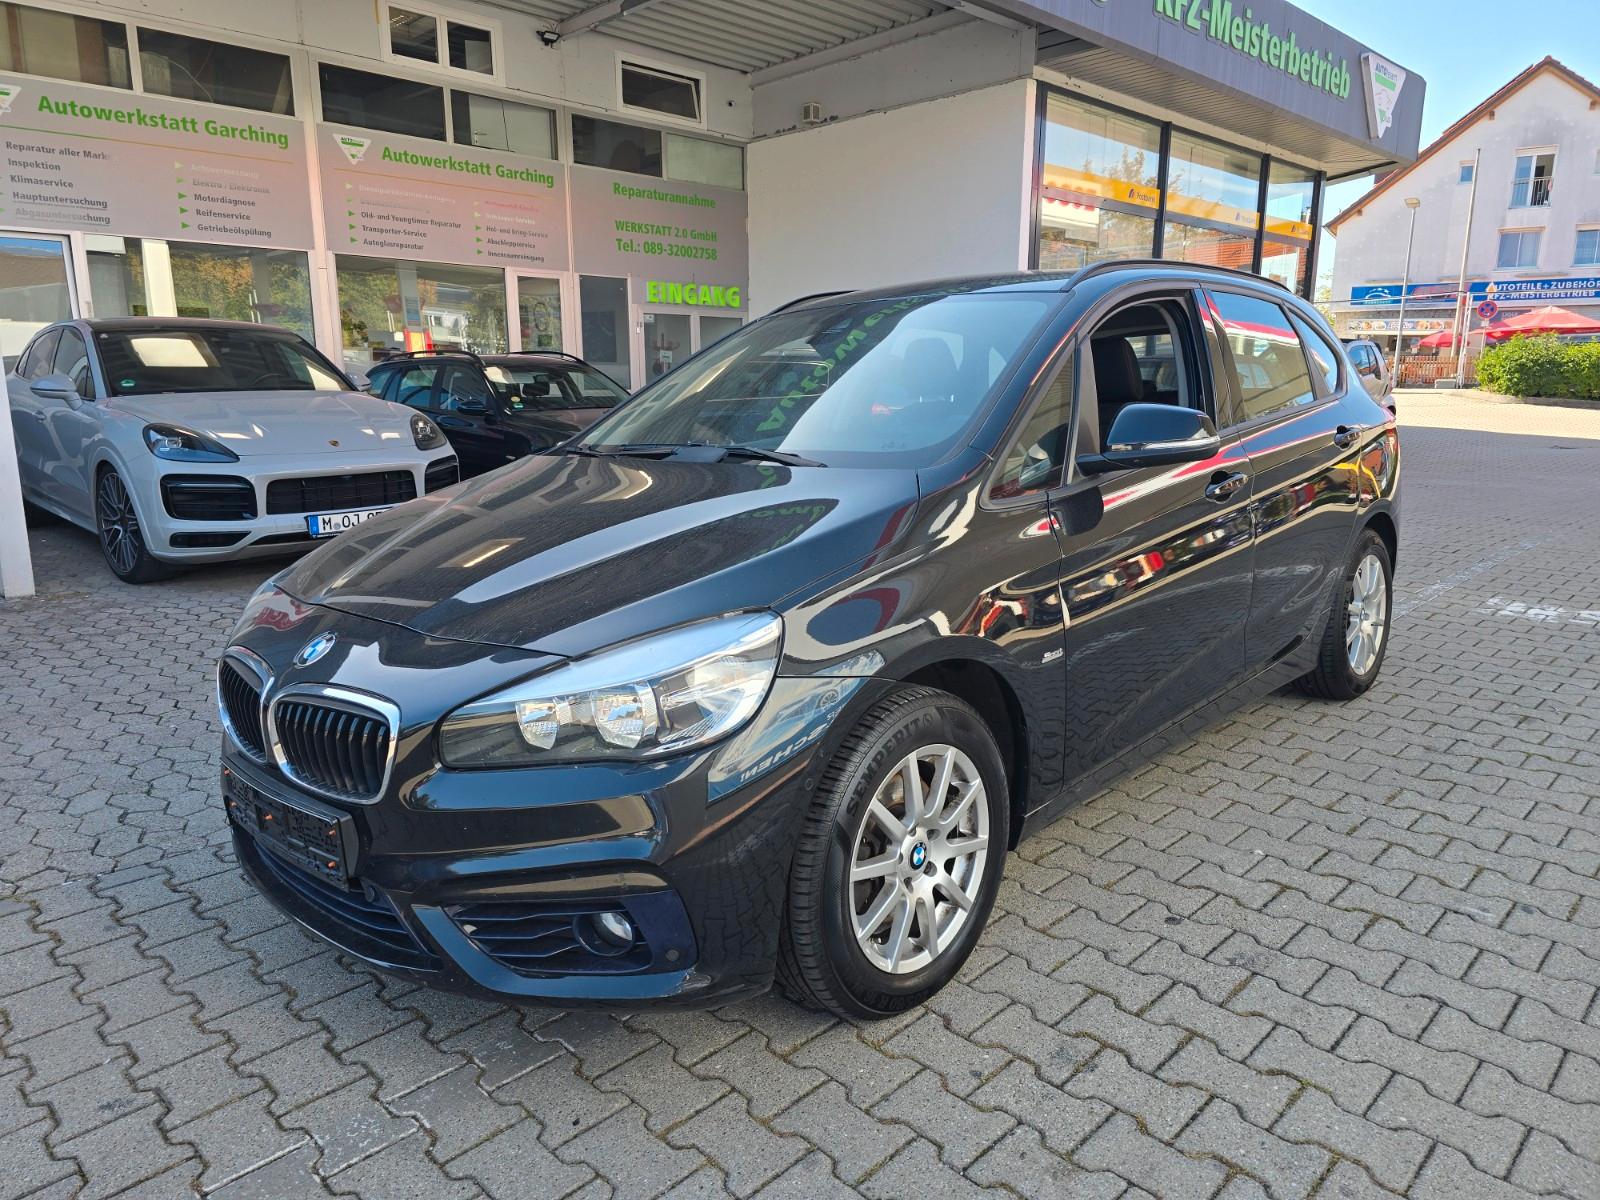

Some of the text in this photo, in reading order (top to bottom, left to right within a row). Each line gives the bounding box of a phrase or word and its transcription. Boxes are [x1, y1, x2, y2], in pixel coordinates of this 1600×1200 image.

[38, 95, 289, 149] Autowerkstatt Garching
[5, 141, 111, 160] Reparatur aller Mark
[8, 158, 61, 171] Inspektion
[382, 146, 555, 188] Autowerkstatt Garching
[10, 174, 74, 188] Klimaservice
[12, 191, 108, 209] Hauptuntersuchung
[194, 193, 256, 207] Motordiagnose
[613, 182, 716, 208] Reparaturannahme
[195, 208, 251, 221] Reifenservice
[197, 223, 272, 239] Getriebeölspülung
[362, 225, 428, 238] Transporter-Service
[615, 220, 717, 242] WERKSTATT 2.0 GmbH
[616, 238, 718, 261] Tel.: 089-32002758
[646, 281, 741, 308] EINGANG
[322, 517, 332, 531] M
